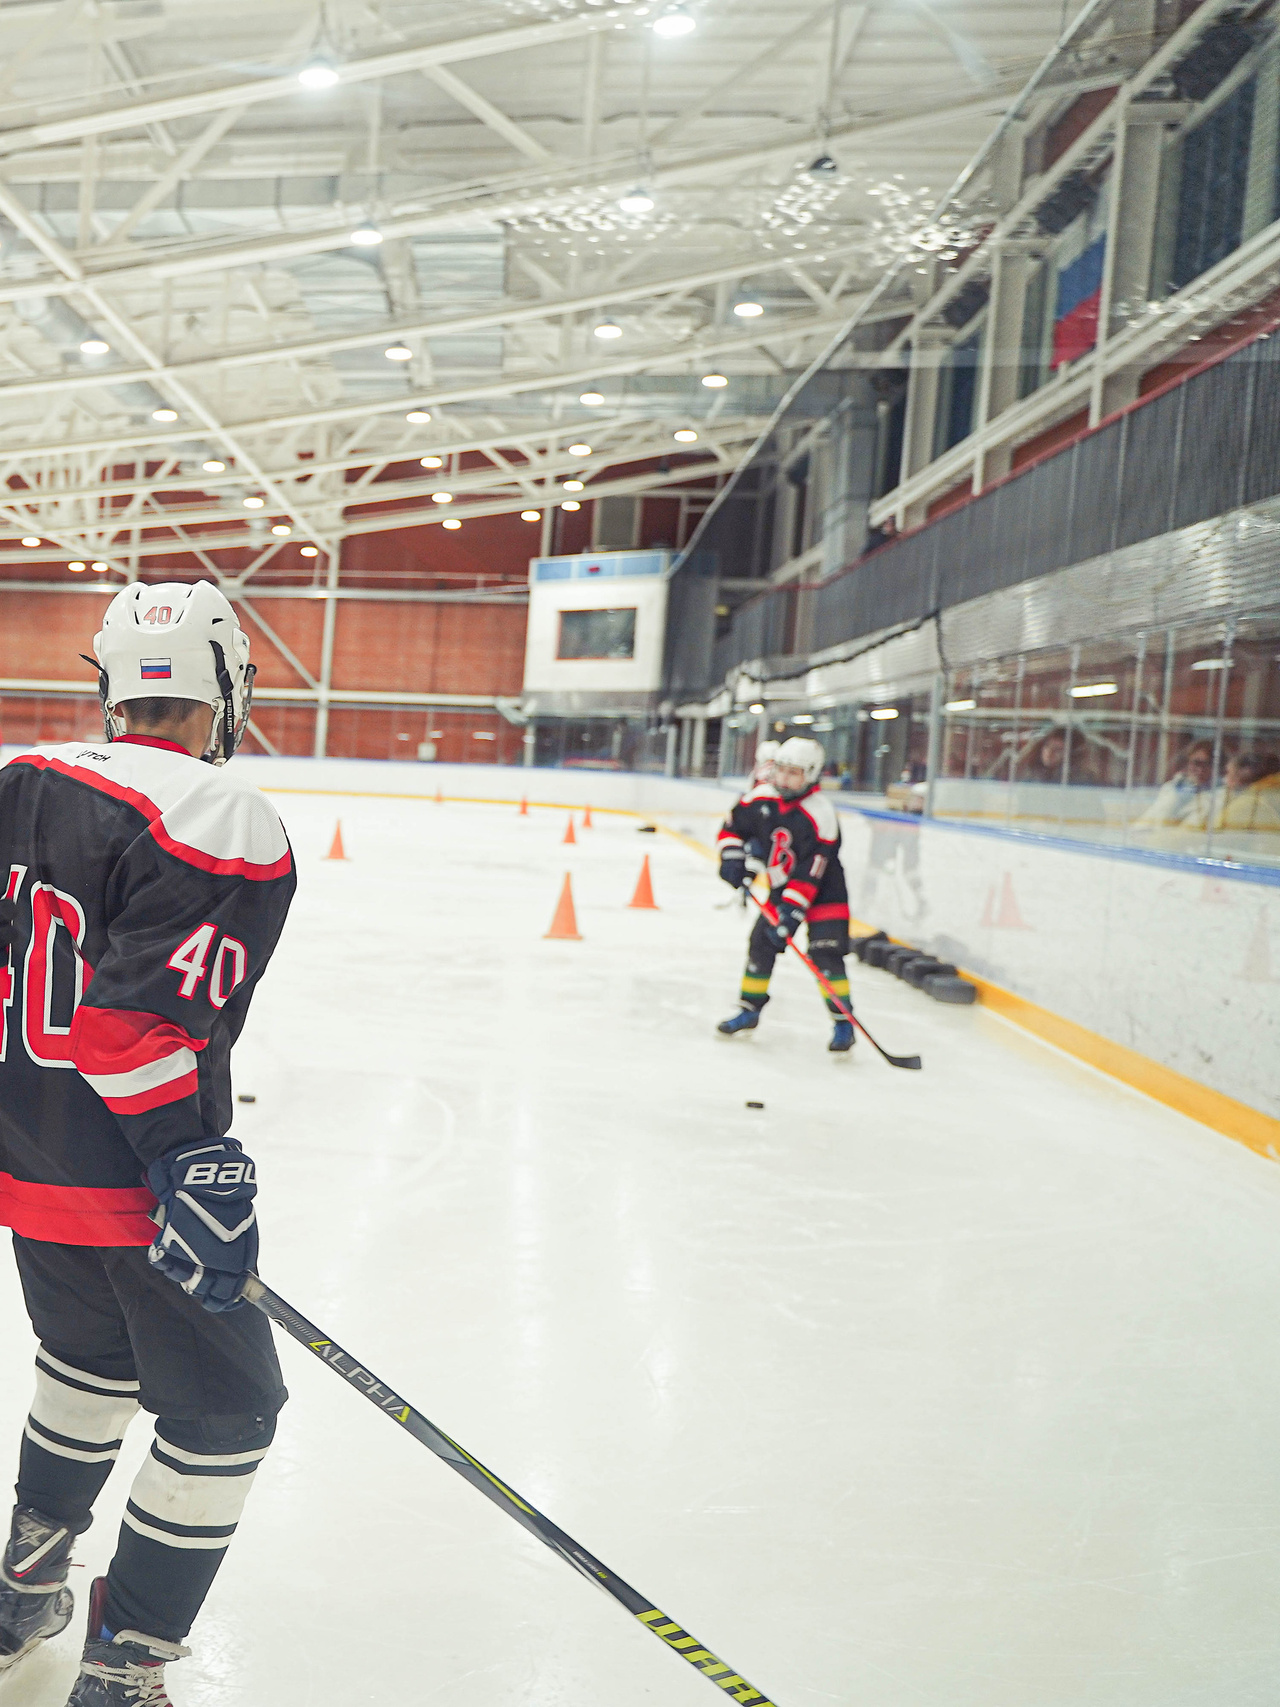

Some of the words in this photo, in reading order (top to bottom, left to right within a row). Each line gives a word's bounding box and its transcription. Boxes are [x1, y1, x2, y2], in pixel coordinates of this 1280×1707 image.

[143, 606, 172, 625] 40
[165, 921, 248, 1010] 40
[308, 1340, 411, 1423] ALPHA
[634, 1609, 778, 1707] WAR
